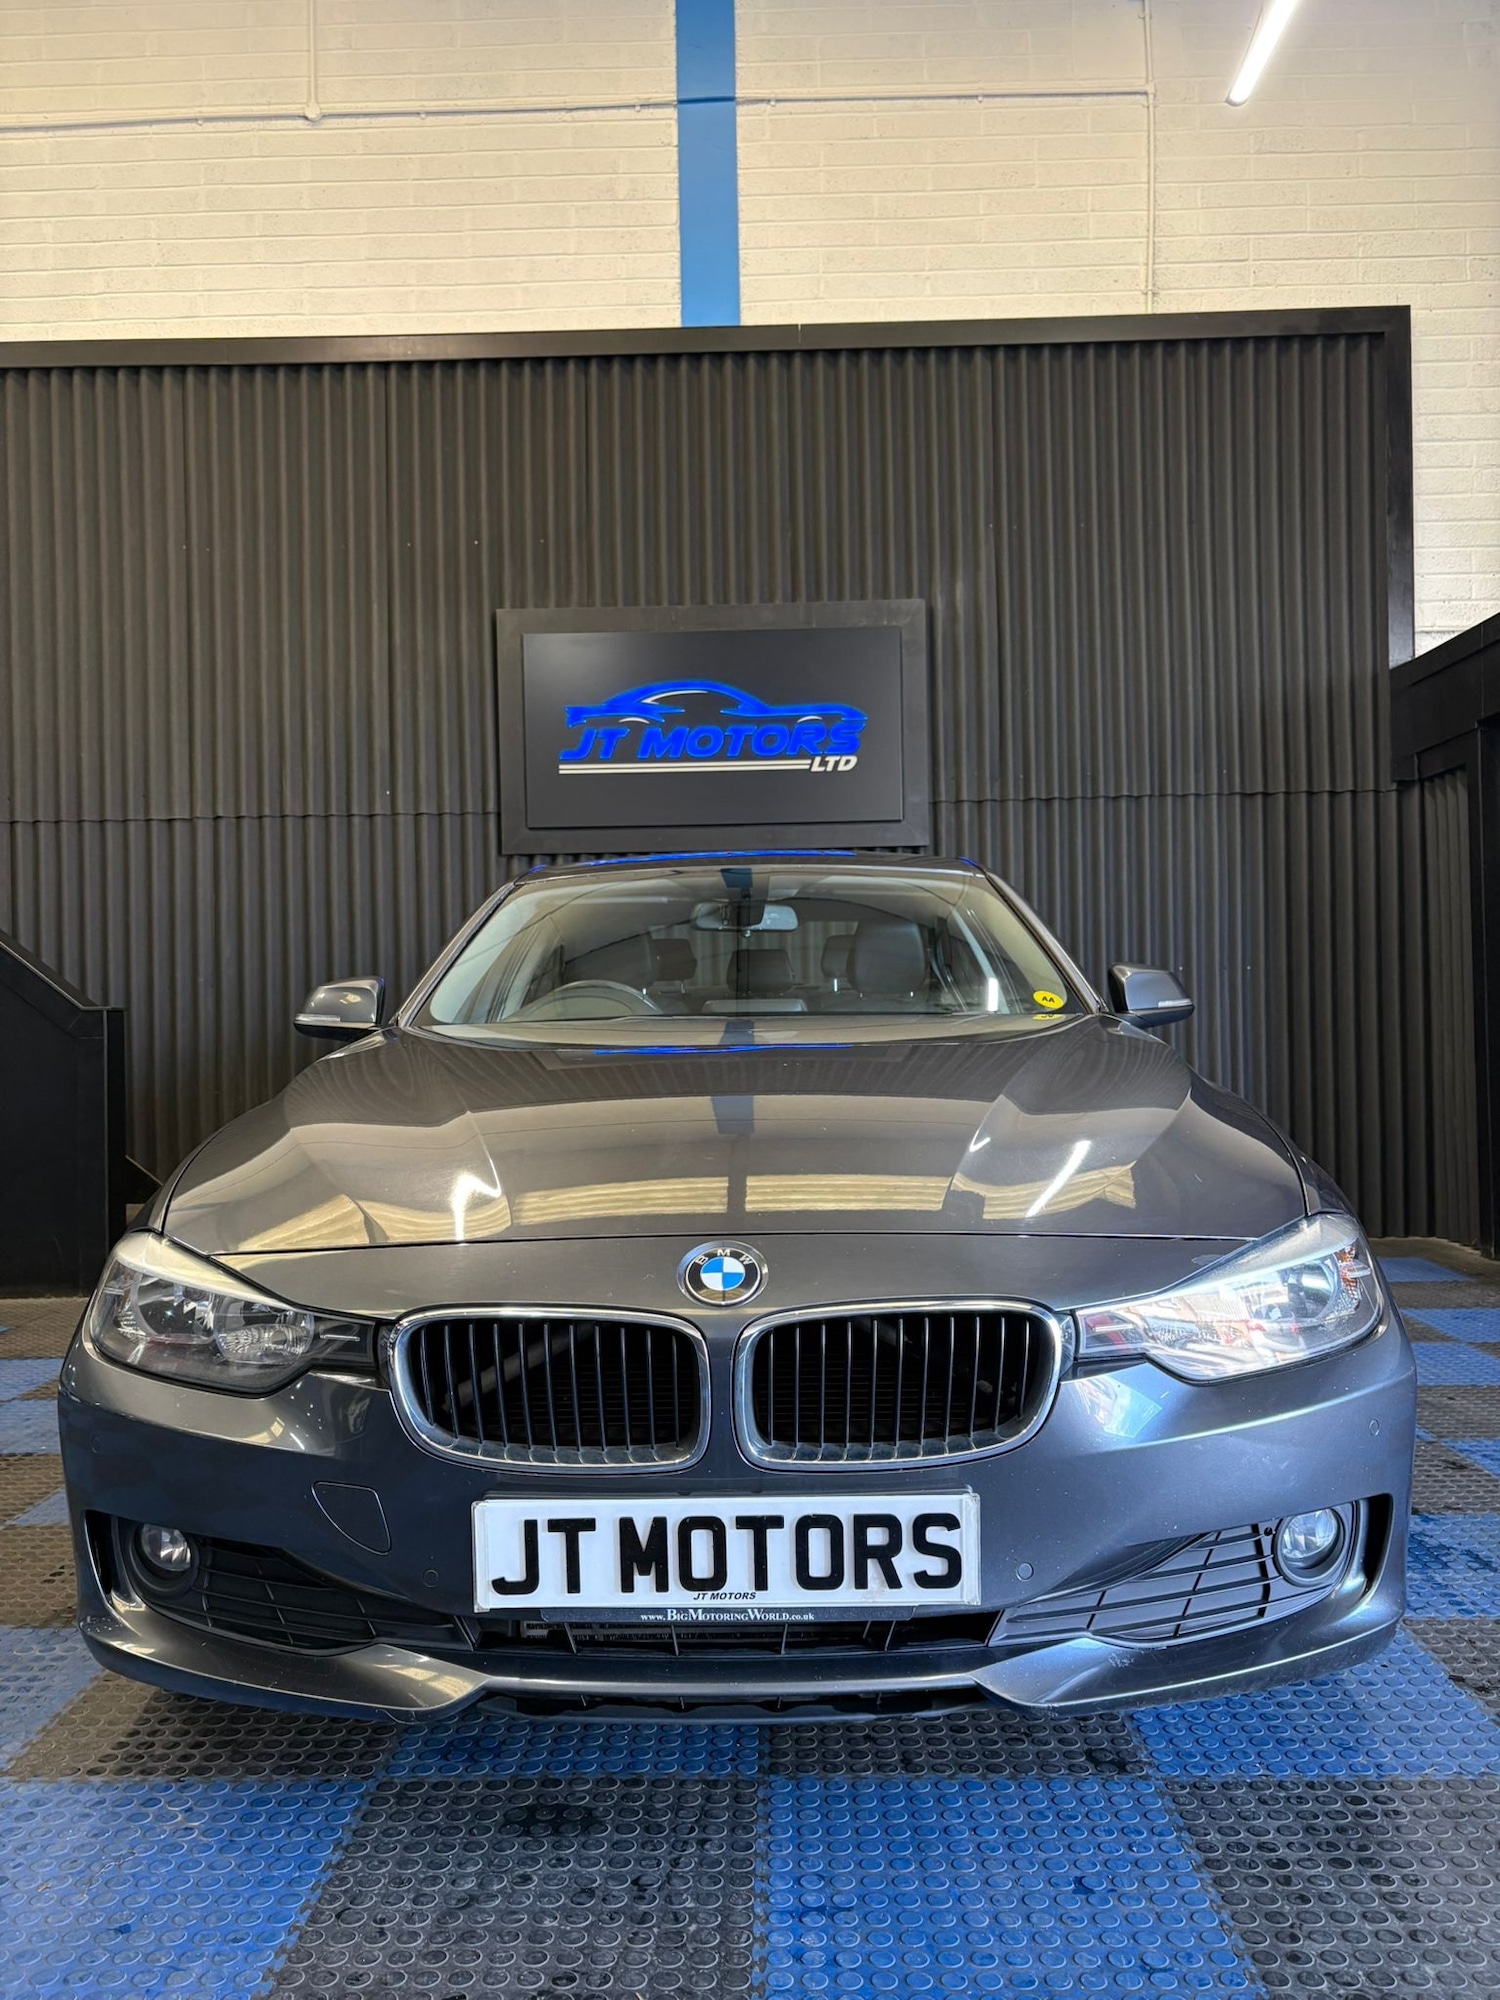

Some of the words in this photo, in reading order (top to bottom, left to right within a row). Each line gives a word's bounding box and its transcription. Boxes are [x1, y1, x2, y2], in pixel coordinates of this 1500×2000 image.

[559, 727, 630, 760] JT
[637, 722, 866, 759] MOTORS
[810, 755, 858, 772] LTD
[694, 1248, 753, 1265] BMW
[491, 1518, 596, 1595] JT
[619, 1513, 962, 1593] MOTORS
[693, 1592, 708, 1601] JT
[709, 1591, 757, 1600] MOTORS
